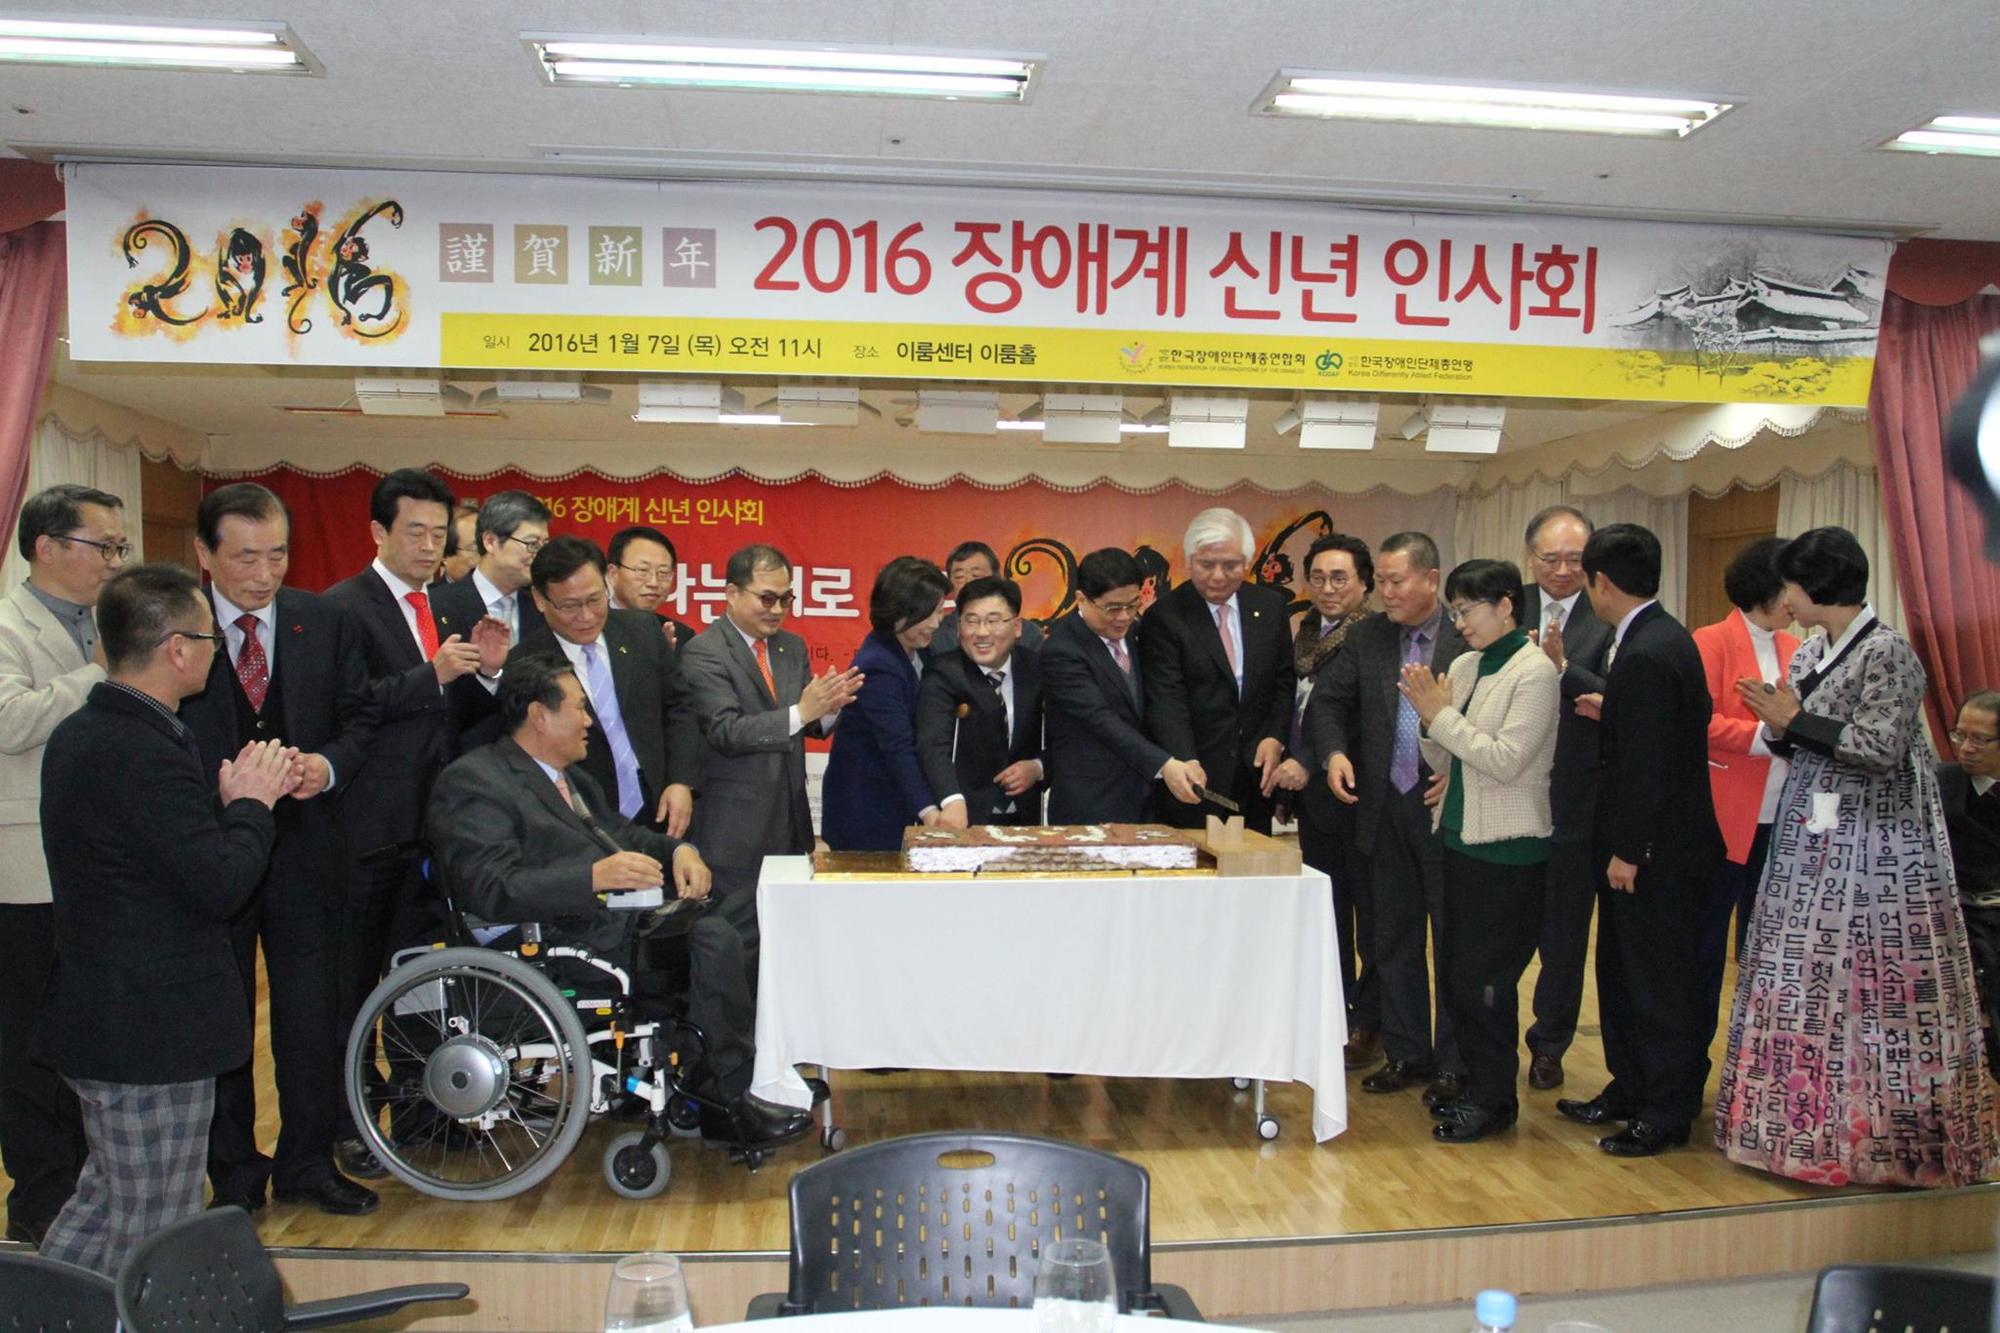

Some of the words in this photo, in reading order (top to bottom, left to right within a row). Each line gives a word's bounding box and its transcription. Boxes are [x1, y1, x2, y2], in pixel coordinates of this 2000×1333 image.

[753, 215, 932, 295] 2016
[951, 220, 1188, 318] 장애계
[1209, 231, 1358, 323] 신년
[1383, 238, 1599, 334] 인사회
[483, 335, 510, 350] 일시
[528, 332, 598, 354] 2016년
[608, 333, 639, 355] 1월
[647, 334, 680, 356] 7일
[687, 334, 721, 357] (목)
[728, 335, 769, 357] 오전
[778, 337, 821, 359] 11시
[853, 345, 880, 359] 장소
[896, 341, 972, 363] 이룸센터
[980, 343, 1037, 365] 이룸홀
[1348, 369, 1370, 377] Korea
[573, 496, 640, 524] 장애계
[645, 497, 690, 525] 신년
[695, 497, 764, 526] 인사회
